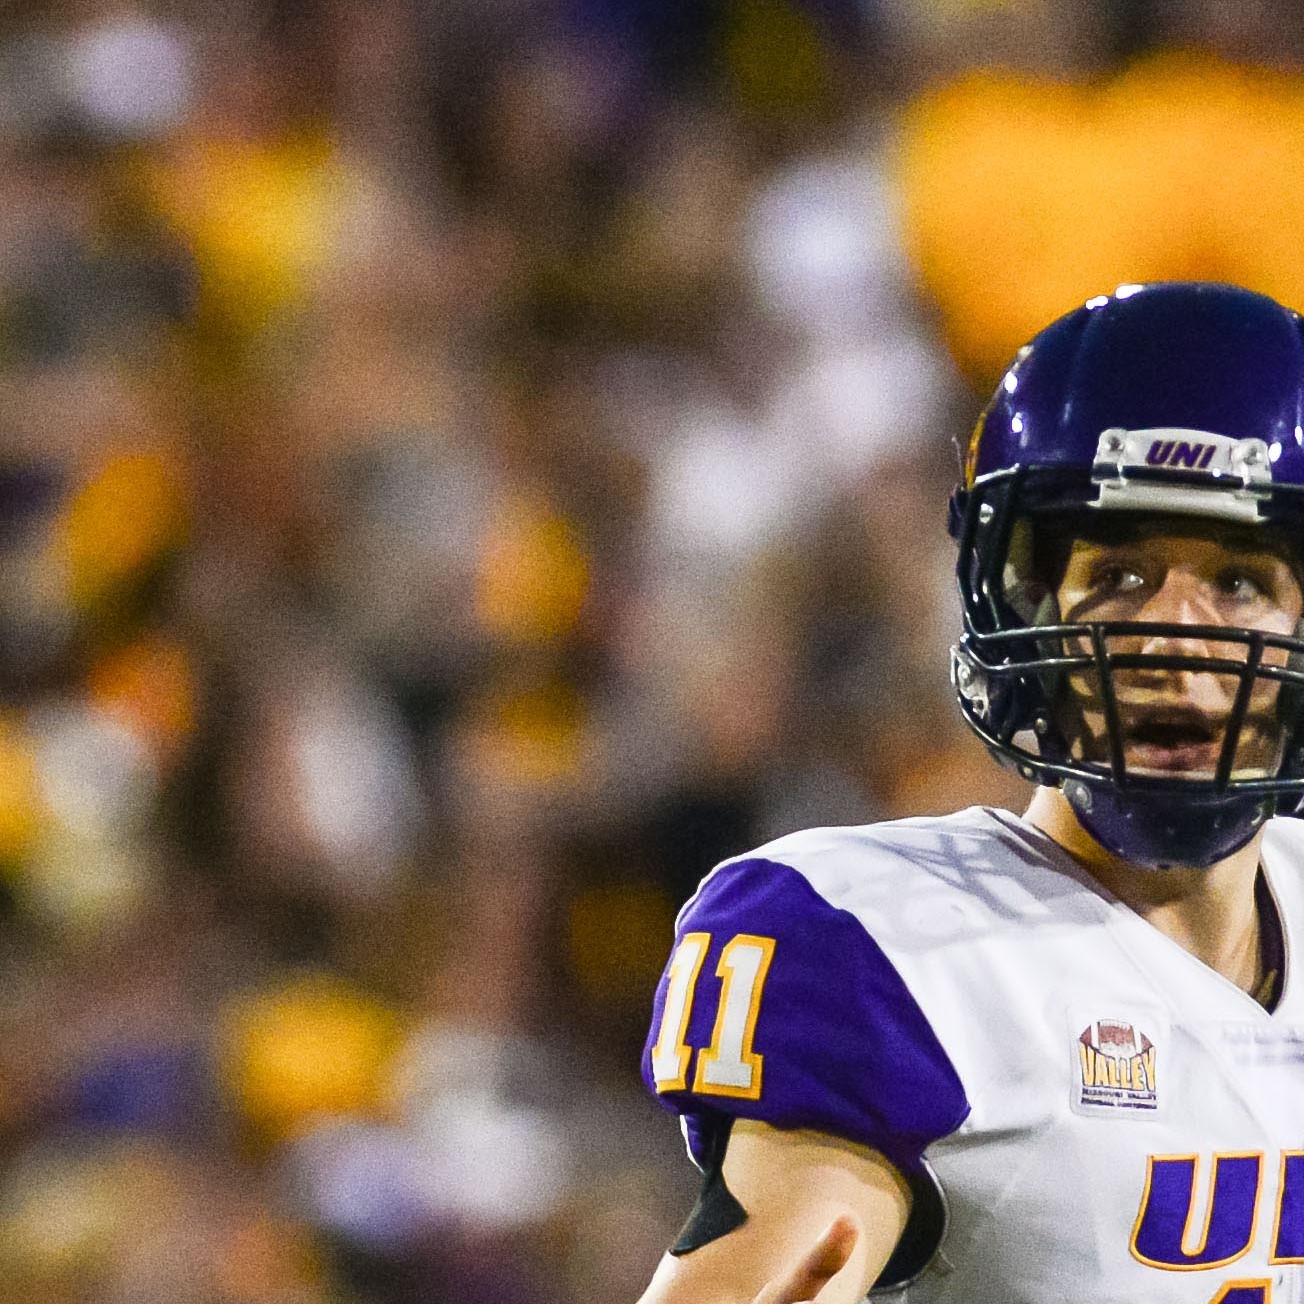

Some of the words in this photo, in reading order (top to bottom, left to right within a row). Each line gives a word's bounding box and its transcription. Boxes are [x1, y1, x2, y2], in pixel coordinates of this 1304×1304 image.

[1144, 439, 1218, 469] UNI
[652, 932, 776, 1100] 11
[1078, 1041, 1156, 1092] VALLEY
